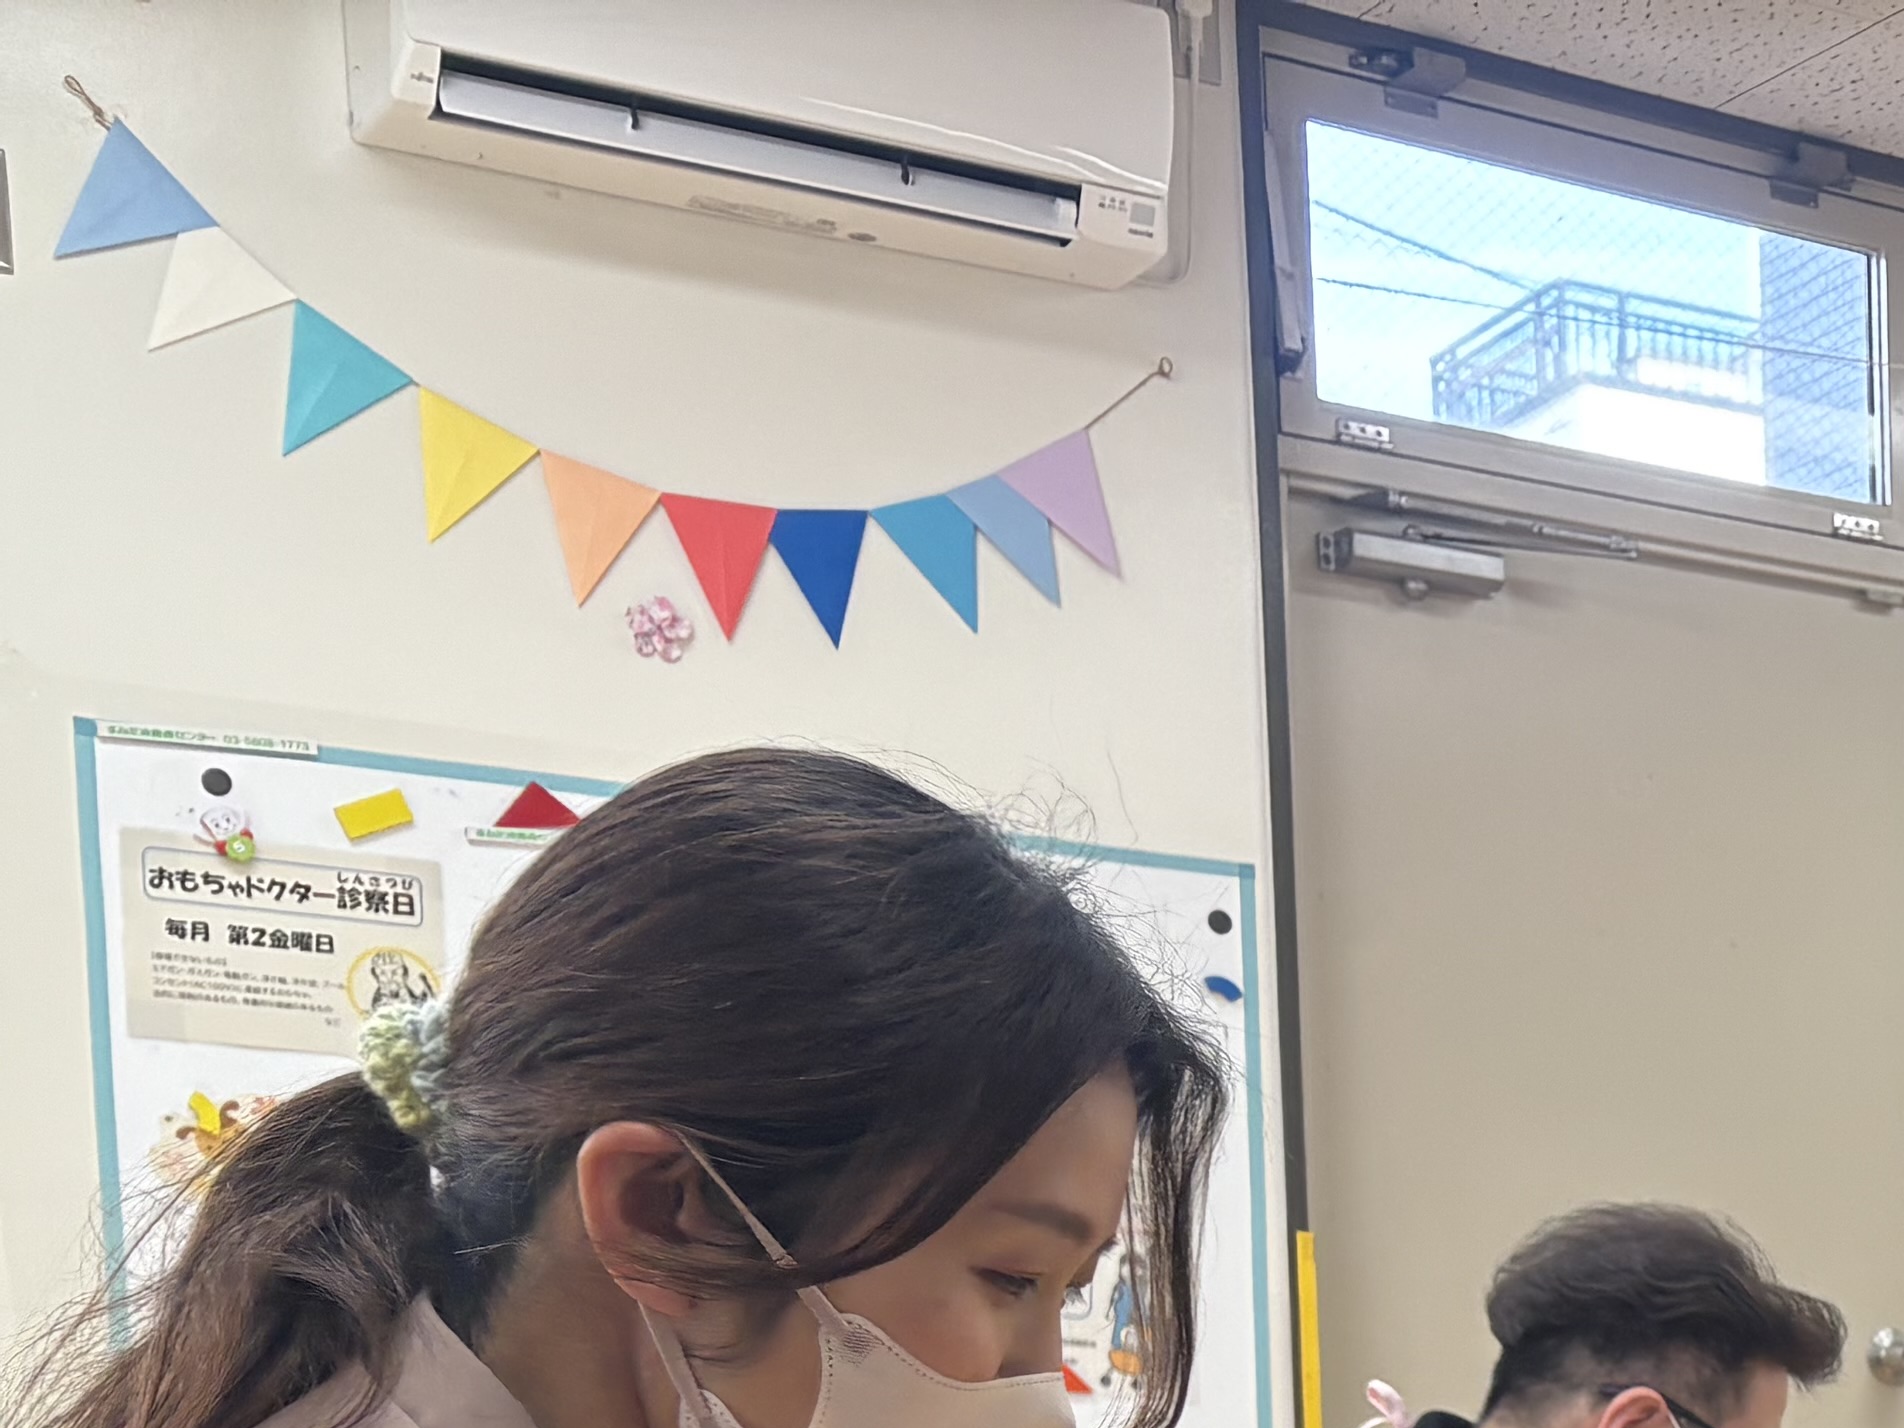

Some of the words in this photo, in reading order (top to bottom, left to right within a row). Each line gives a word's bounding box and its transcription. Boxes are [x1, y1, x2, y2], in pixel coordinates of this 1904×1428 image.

[148, 867, 416, 916] おもちゃドクター診察日
[337, 869, 415, 891] しんさつび
[164, 917, 210, 942] 毎月
[227, 923, 336, 954] 第2金曜日
